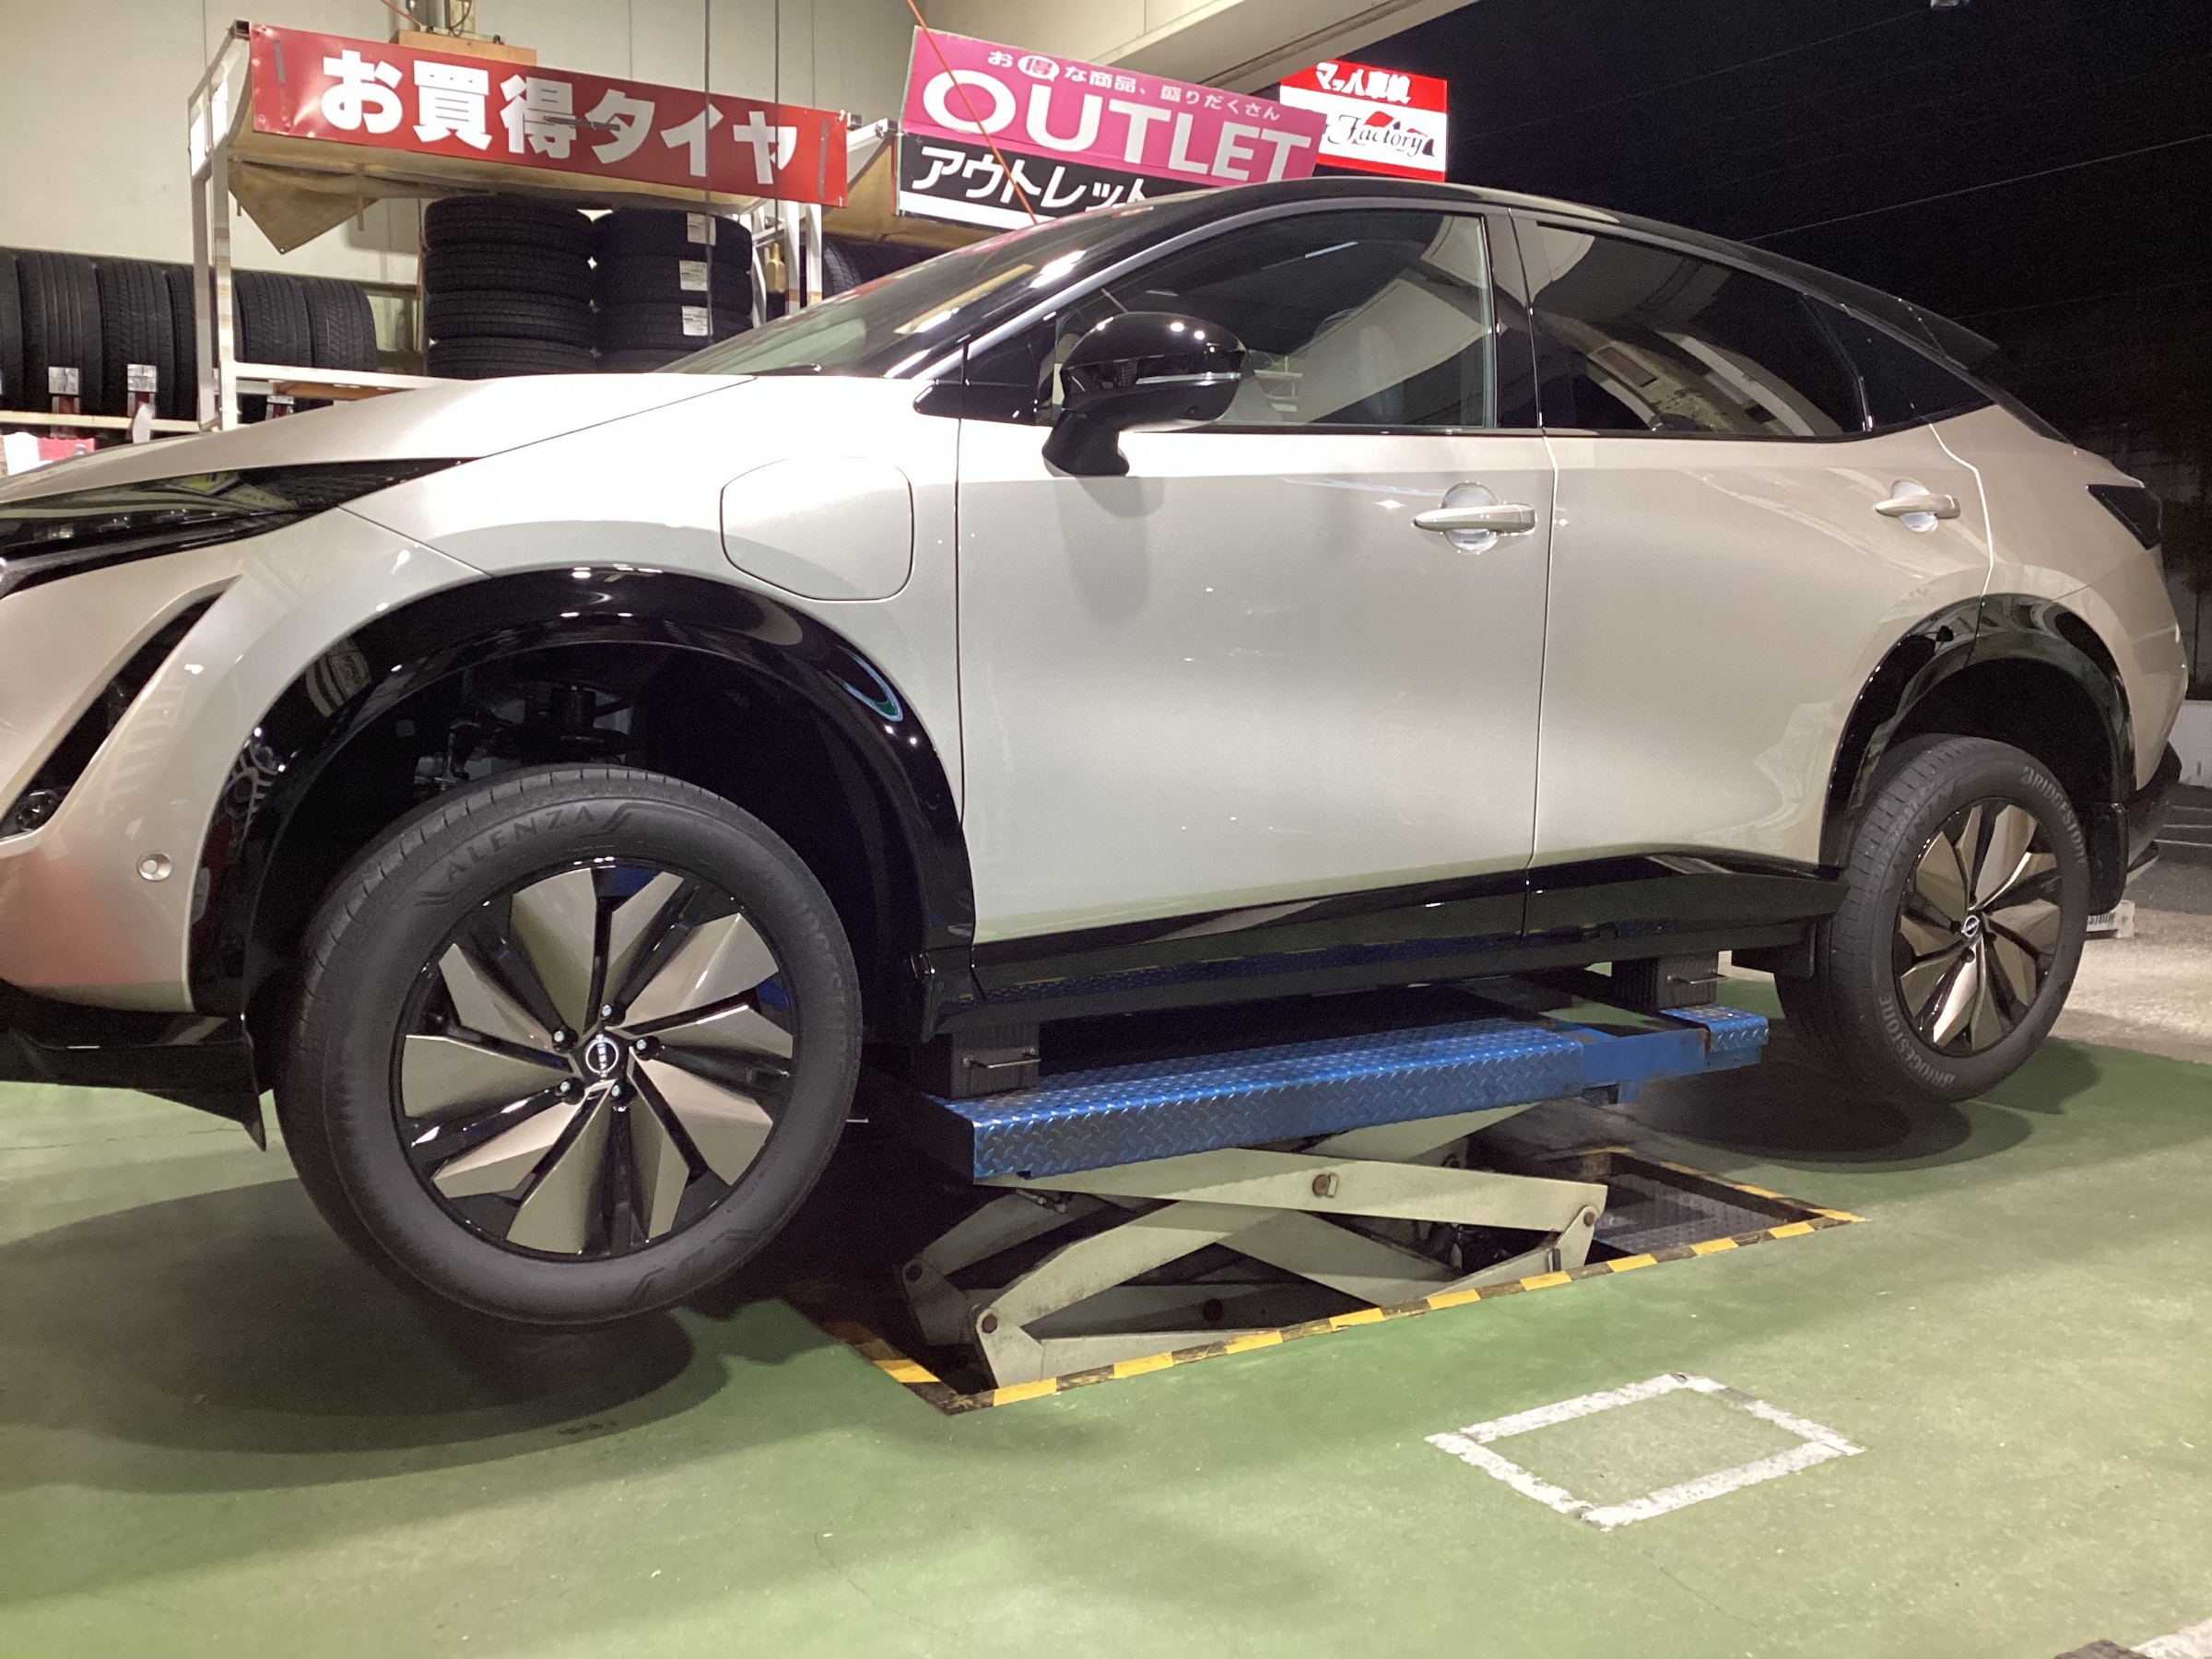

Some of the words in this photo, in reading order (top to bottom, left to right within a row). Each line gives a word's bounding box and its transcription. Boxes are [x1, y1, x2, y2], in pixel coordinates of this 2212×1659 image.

[320, 49, 797, 184] お買得タイヤ
[923, 69, 1312, 184] OUTLET
[1326, 113, 1426, 158] Factory
[444, 805, 595, 882] ALENZA
